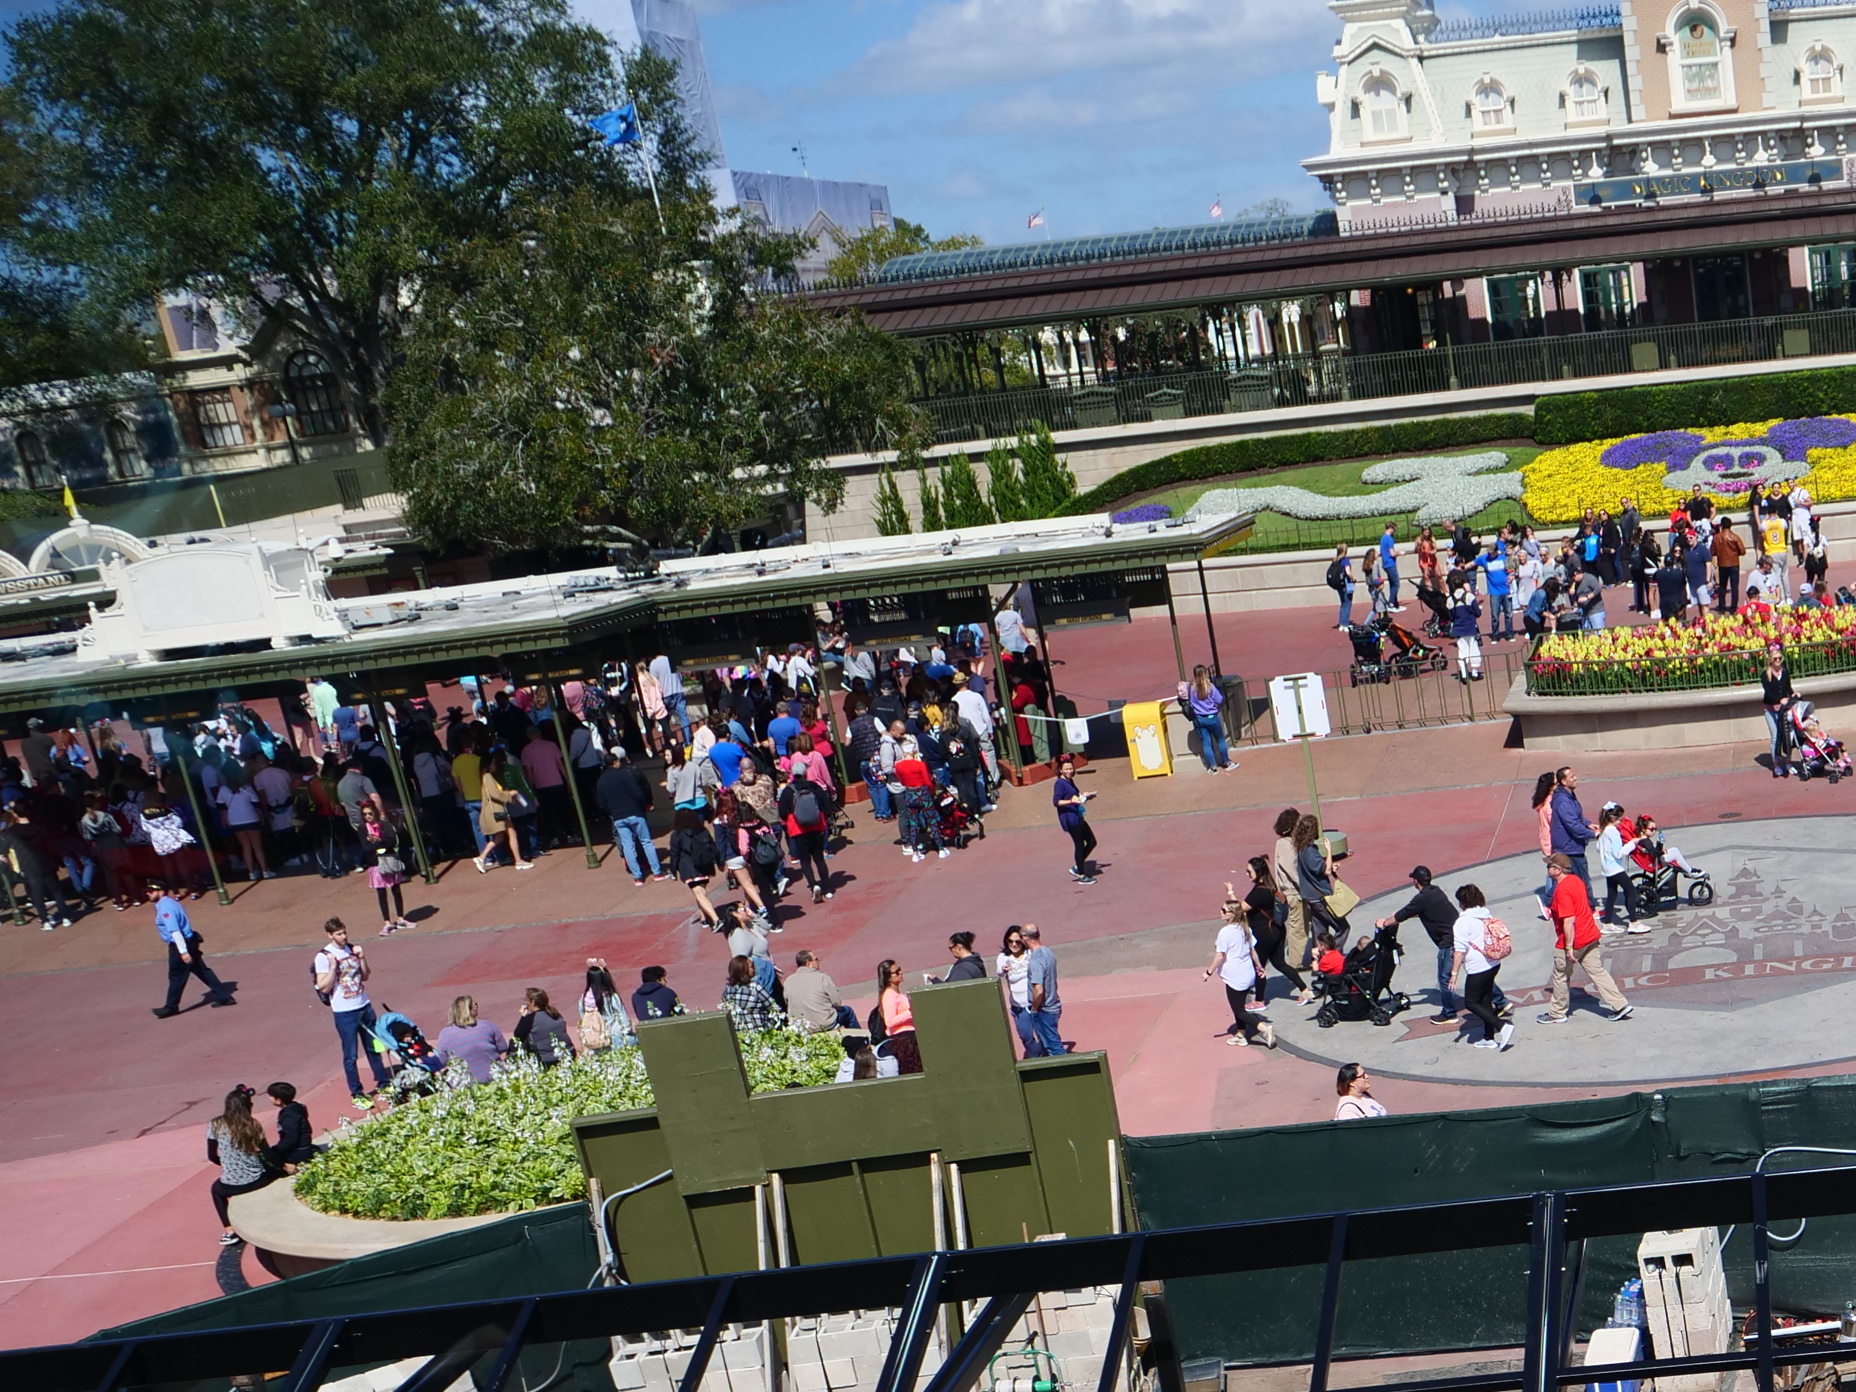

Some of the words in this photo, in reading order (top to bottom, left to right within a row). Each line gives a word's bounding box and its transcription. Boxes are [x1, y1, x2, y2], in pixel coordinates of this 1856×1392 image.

[1632, 176, 1691, 196] MAGIC
[1700, 168, 1787, 190] KINGDOM
[1771, 531, 1779, 542] 8
[1505, 973, 1670, 1004] MIC
